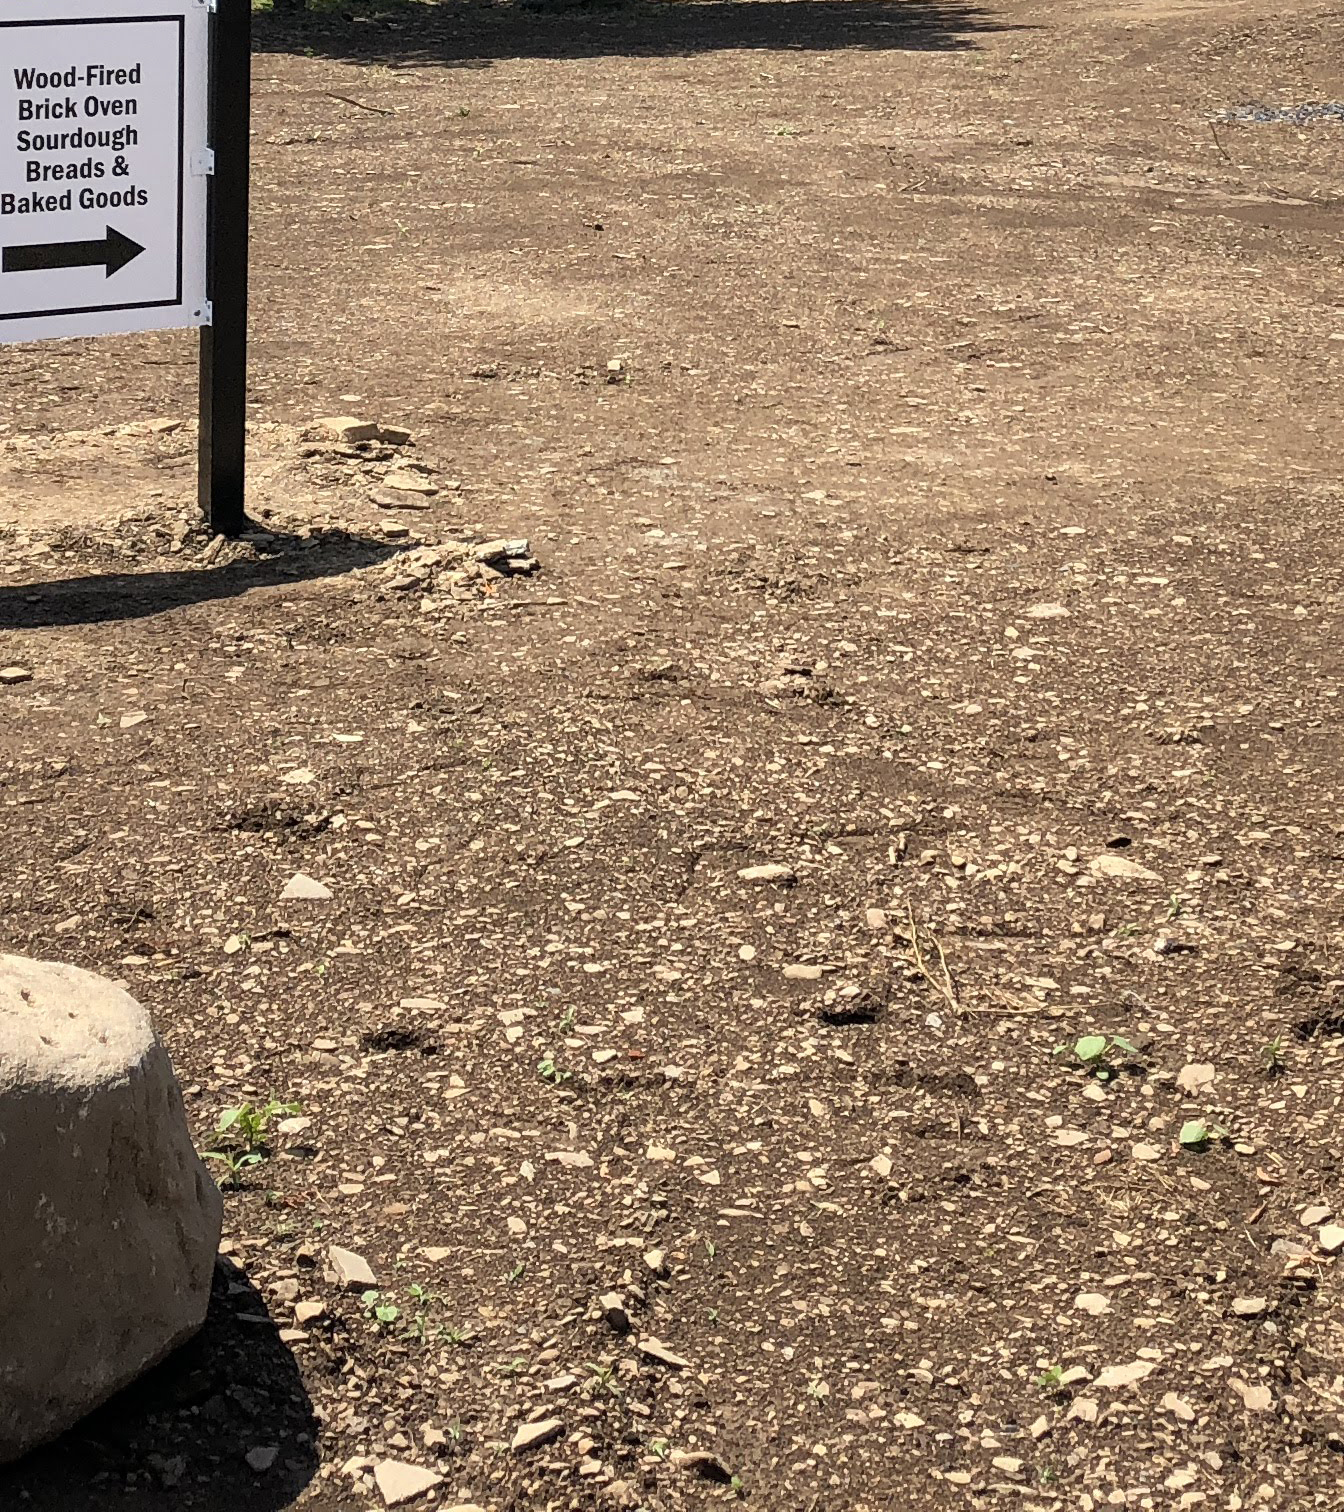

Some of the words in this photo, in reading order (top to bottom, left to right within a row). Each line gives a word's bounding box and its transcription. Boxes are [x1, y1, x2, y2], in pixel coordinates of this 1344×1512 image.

[13, 63, 141, 90] Wood-Fired
[18, 97, 78, 120] Brick
[84, 95, 137, 117] Oven
[16, 125, 138, 152] Sourdough
[26, 157, 105, 182] Breads
[111, 155, 130, 177] &
[1, 189, 72, 215] Baked
[79, 185, 148, 209] Goods
